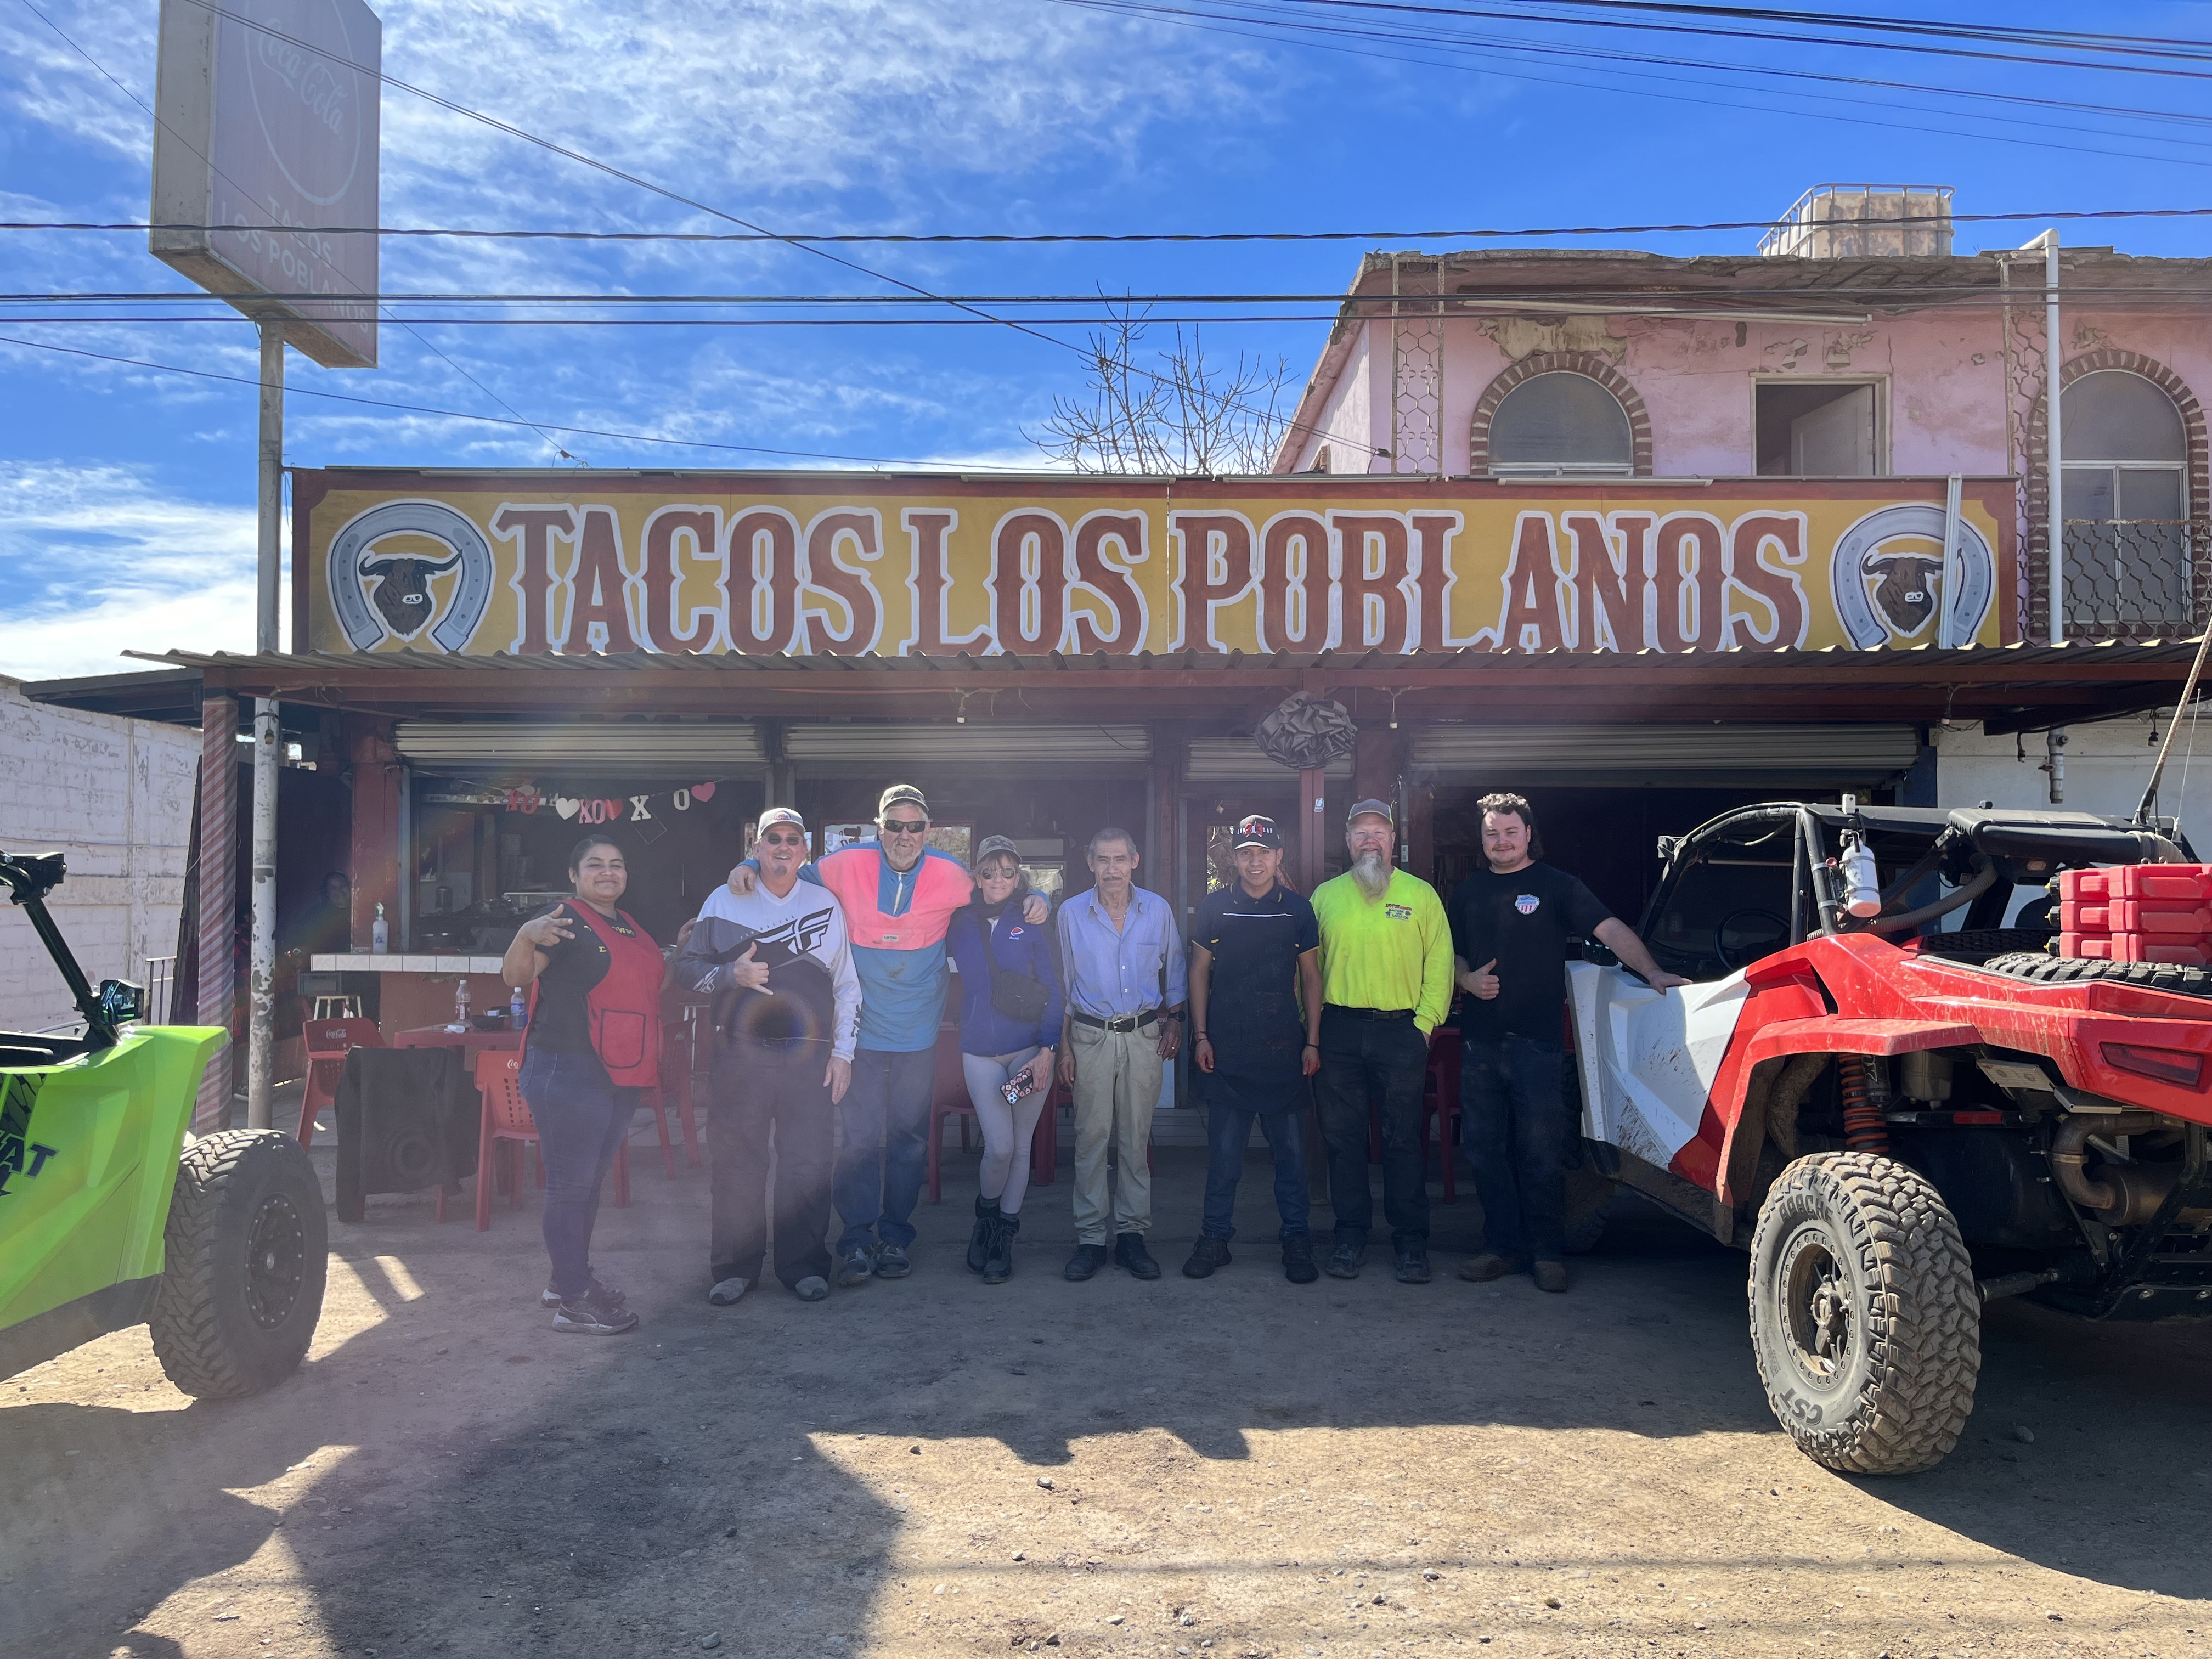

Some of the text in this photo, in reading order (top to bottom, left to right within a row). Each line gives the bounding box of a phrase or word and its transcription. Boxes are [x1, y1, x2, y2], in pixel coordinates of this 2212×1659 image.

[268, 194, 332, 268] TACOS
[221, 200, 369, 334] LOS POBLANOS
[489, 503, 1808, 657] TACOS LOS POBLANOS
[0, 1129, 59, 1178] AT
[1779, 1193, 1833, 1228] APACHE
[1779, 1387, 1824, 1426] CST
